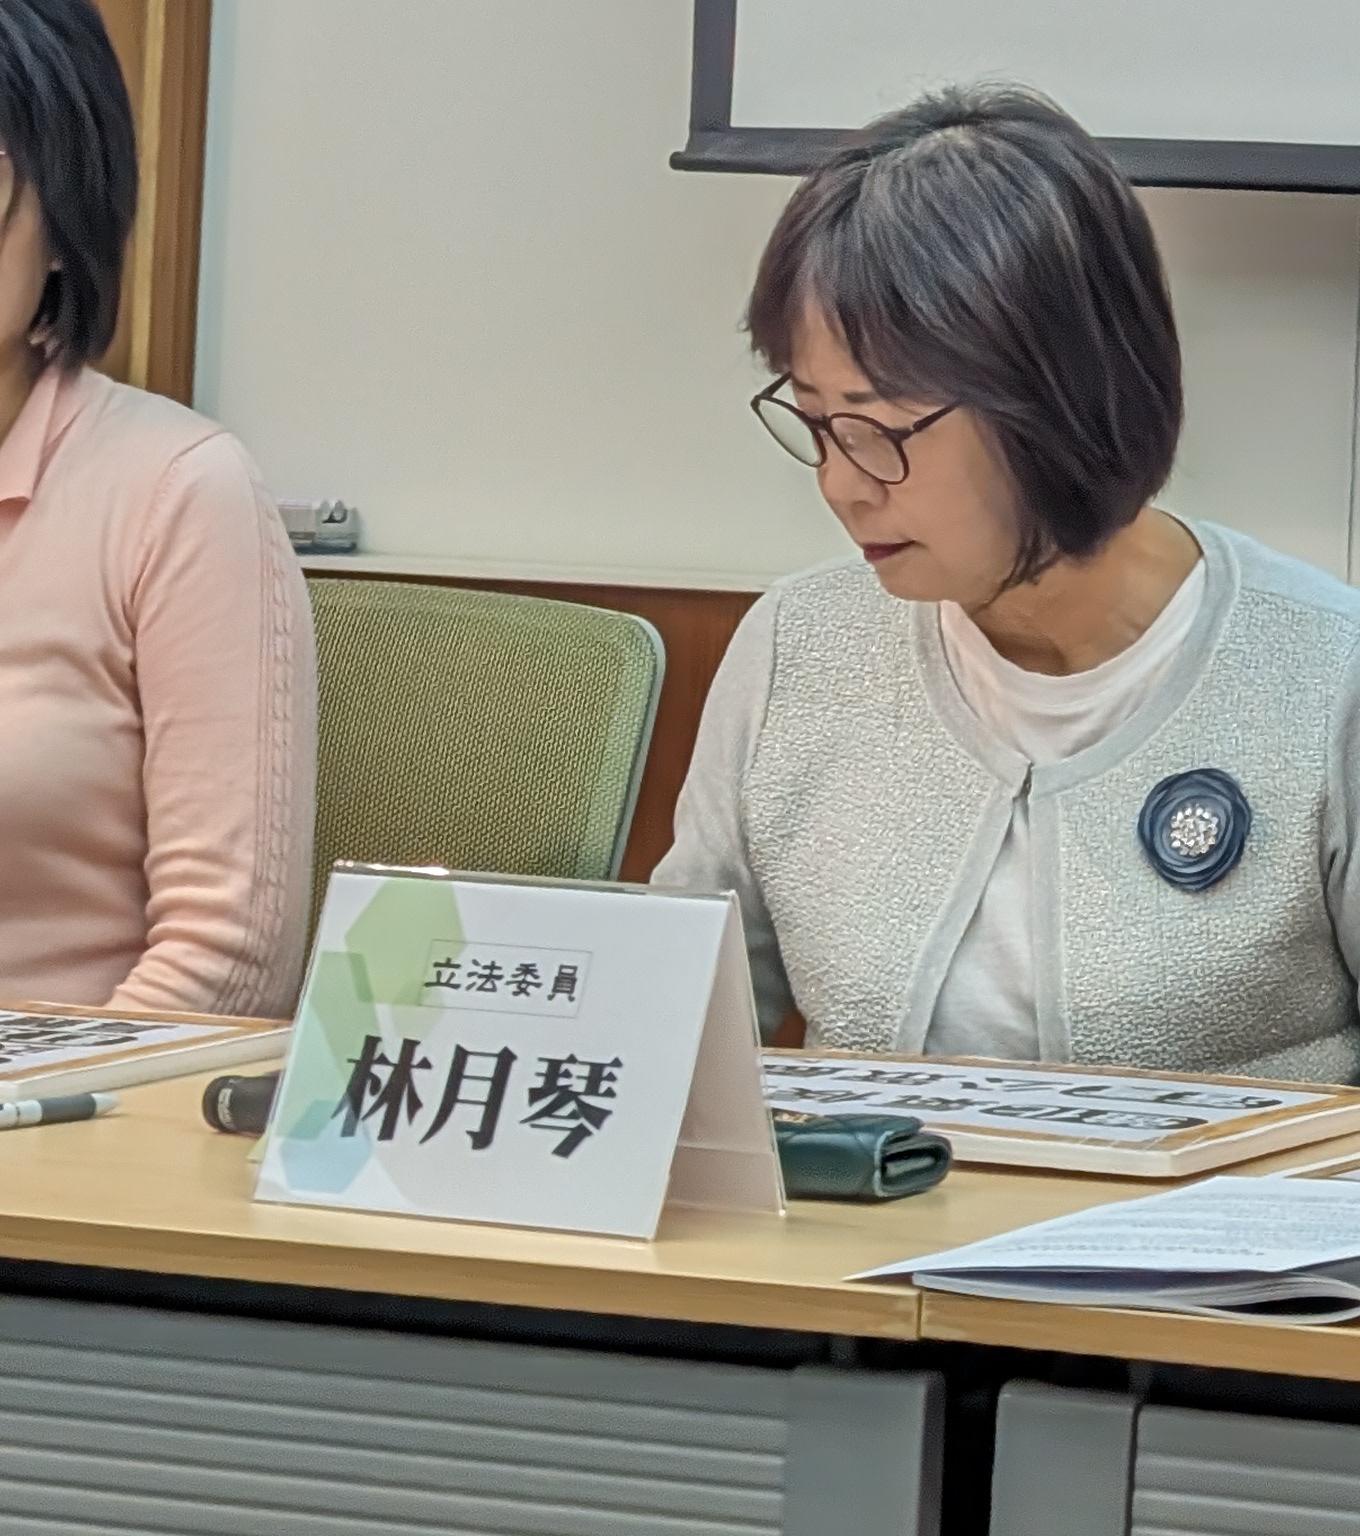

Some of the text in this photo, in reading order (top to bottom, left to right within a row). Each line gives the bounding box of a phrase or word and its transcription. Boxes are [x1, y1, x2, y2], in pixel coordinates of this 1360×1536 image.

[423, 957, 581, 1004] 立法委員
[331, 1034, 625, 1159] 林月琴
